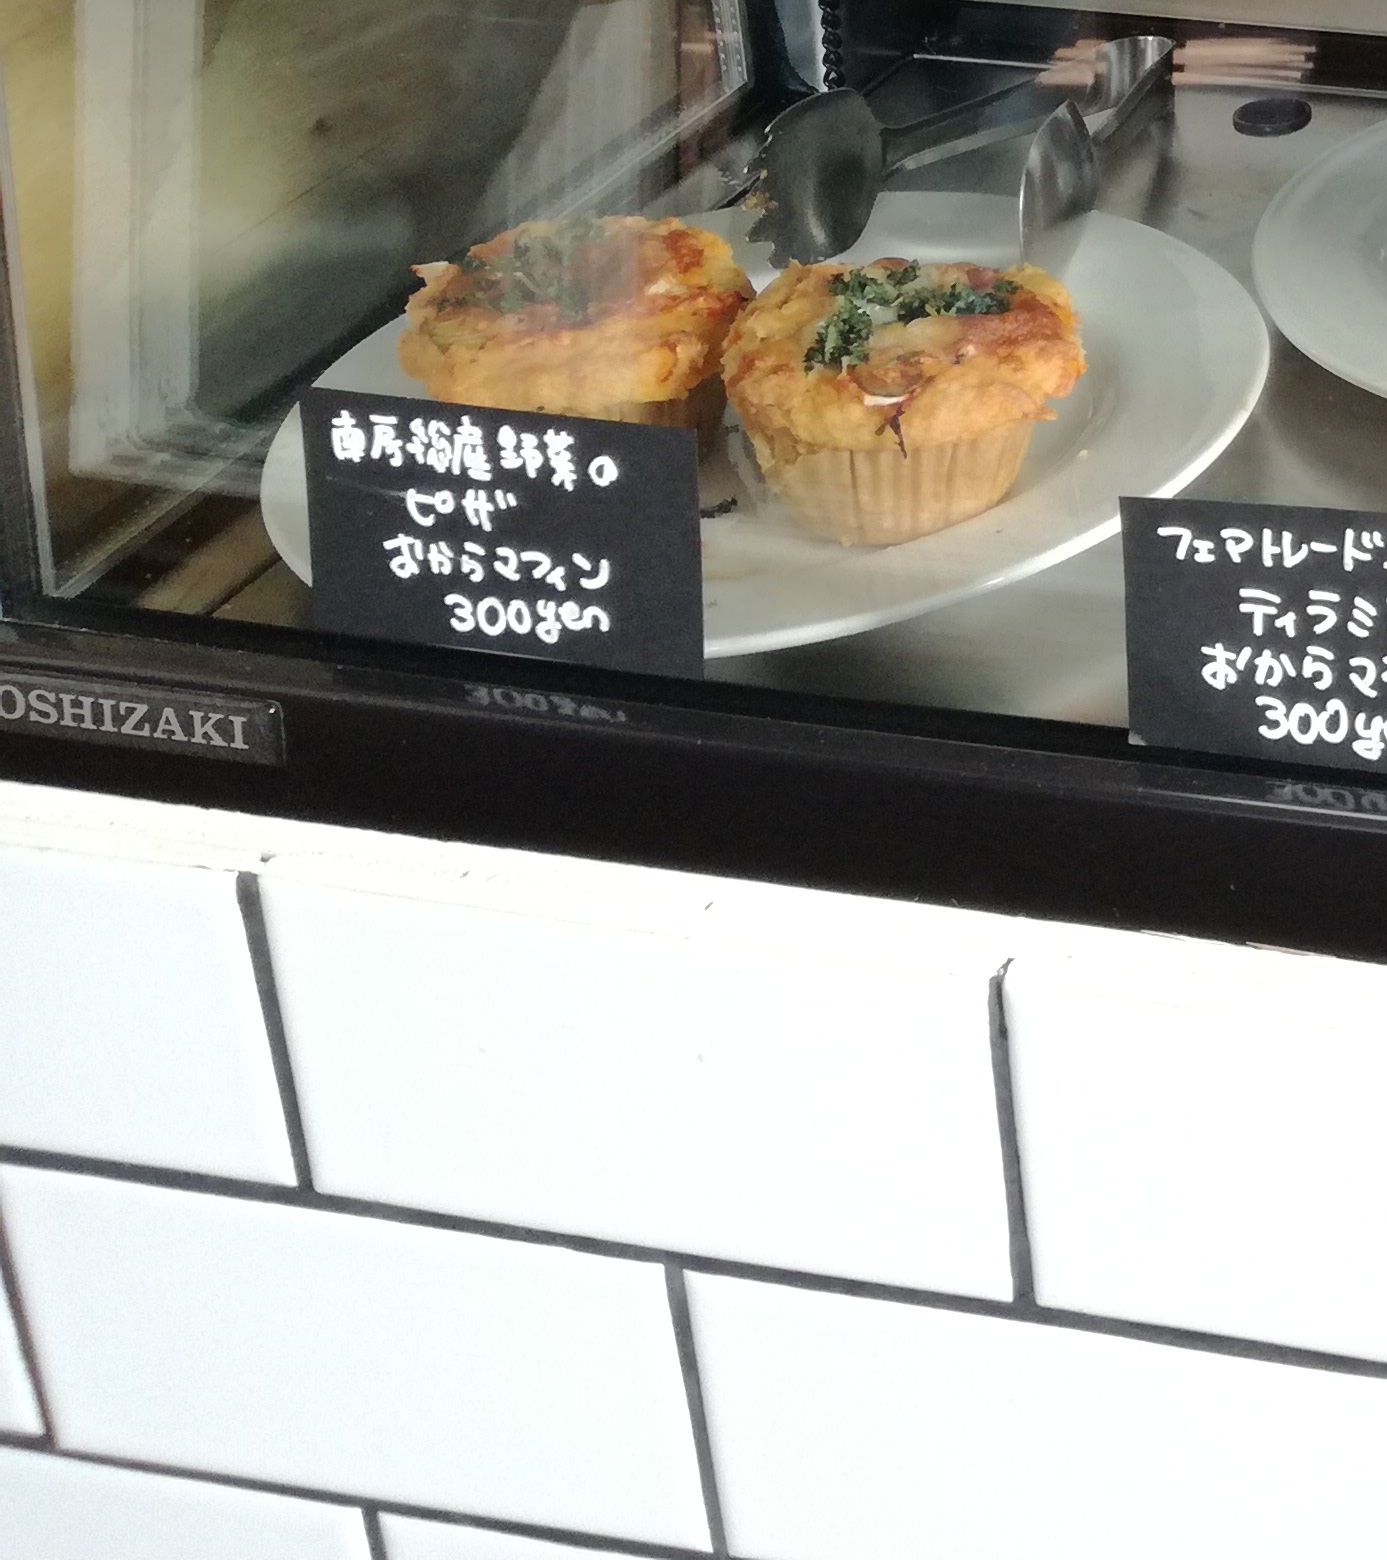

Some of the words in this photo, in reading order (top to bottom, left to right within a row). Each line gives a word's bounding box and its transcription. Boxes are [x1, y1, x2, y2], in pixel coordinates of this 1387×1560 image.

[406, 488, 518, 531] ピザ
[383, 533, 610, 590] おからマフィン
[444, 593, 610, 644] 300yen
